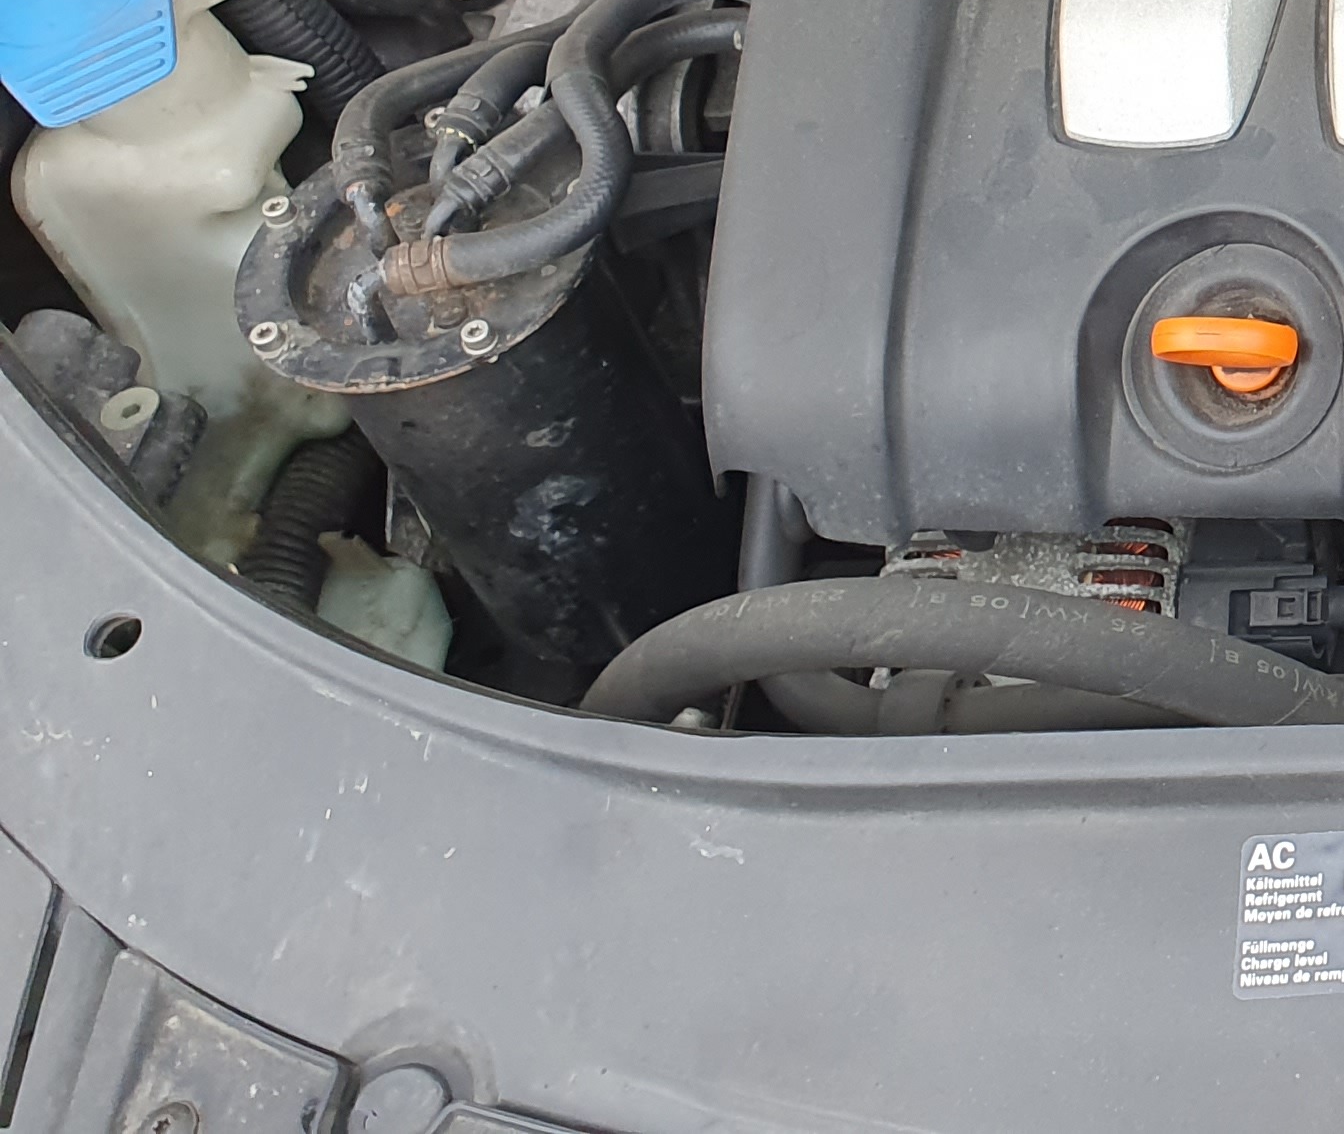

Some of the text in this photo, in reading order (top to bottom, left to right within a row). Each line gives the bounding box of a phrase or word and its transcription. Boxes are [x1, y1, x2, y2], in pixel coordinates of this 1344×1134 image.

[1248, 841, 1295, 871] AC
[1246, 873, 1322, 891] Kältemittel
[1245, 890, 1322, 907] Refrigerant
[1244, 909, 1290, 923] Moyen
[1296, 906, 1312, 919] de
[1243, 938, 1314, 954] Füllmenge
[1241, 952, 1327, 971] Charge level
[1240, 971, 1288, 987] Niveau
[1293, 969, 1309, 983] de
